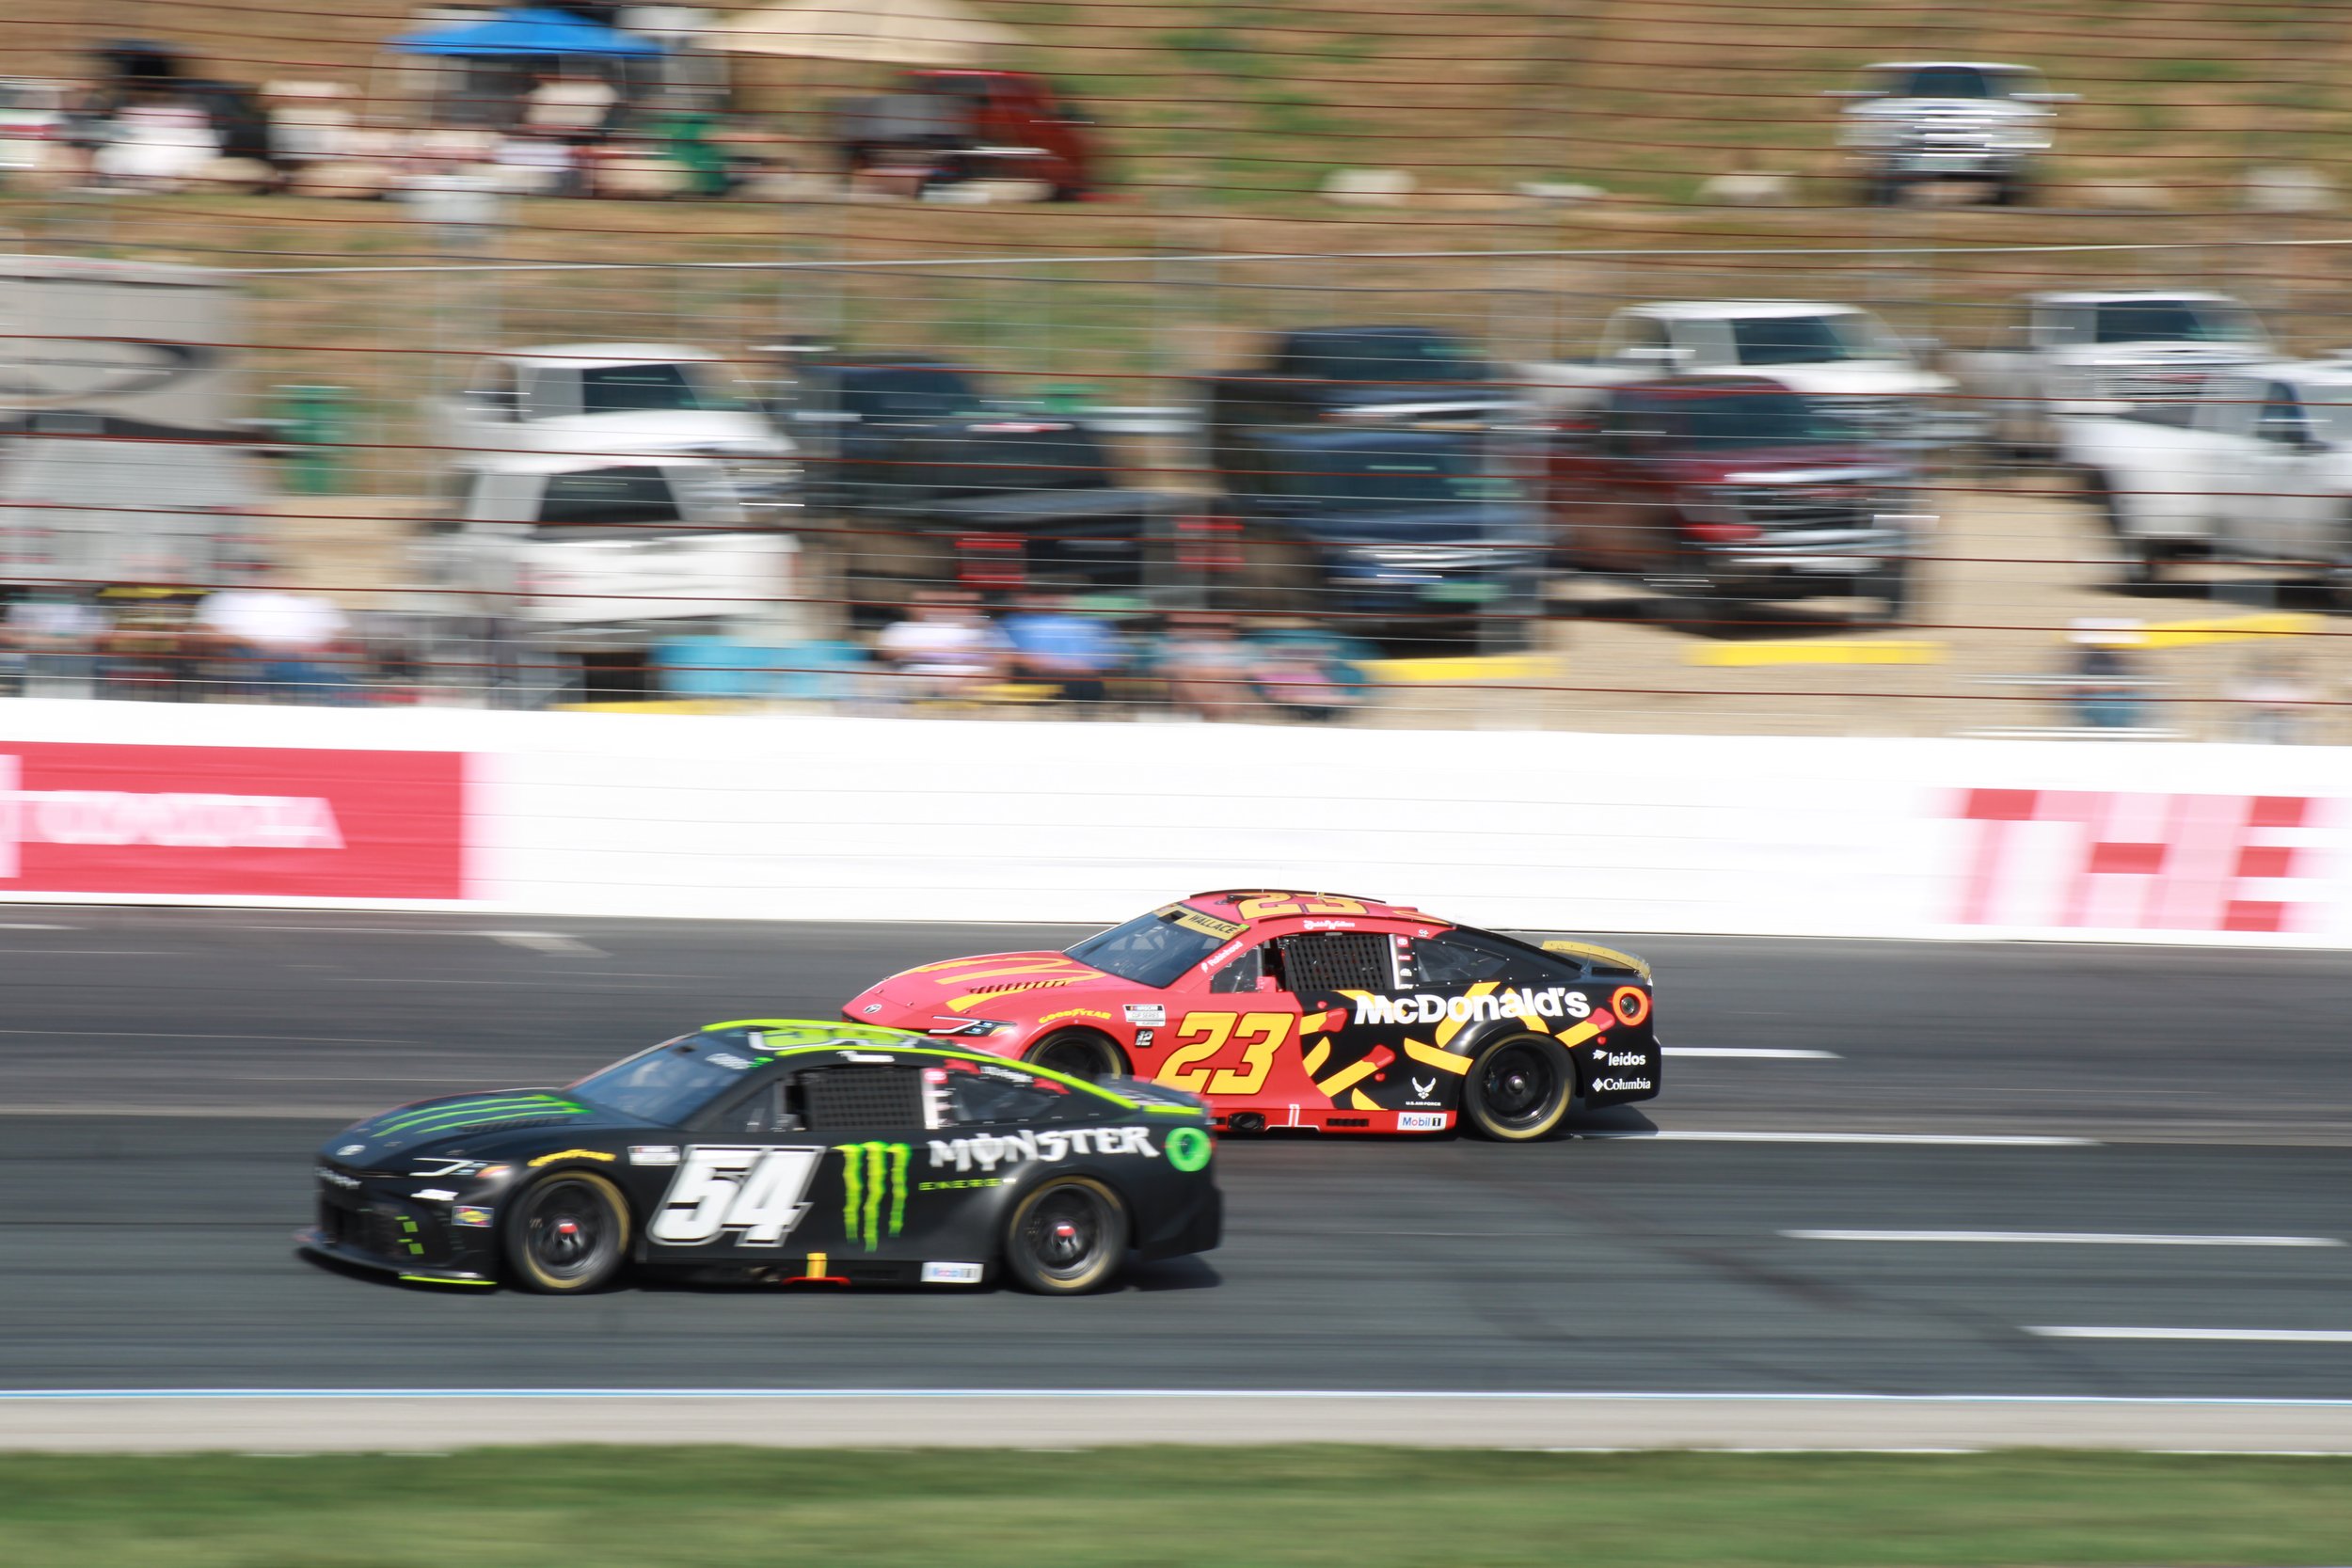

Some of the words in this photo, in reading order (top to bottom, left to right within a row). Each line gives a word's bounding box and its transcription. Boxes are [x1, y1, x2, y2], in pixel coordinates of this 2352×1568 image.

[1940, 788, 2333, 932] THE
[1188, 913, 1236, 934] WALLACE
[1039, 1007, 1112, 1024] GOODYEAR
[1354, 988, 1591, 1024] McDonald's
[1135, 1030, 1153, 1046] 12
[1151, 1011, 1295, 1095] 23
[1608, 1052, 1646, 1067] leidos
[1603, 1078, 1651, 1090] Columbia
[1402, 1117, 1430, 1126] Mobil
[928, 1126, 1160, 1171] MONSTER
[645, 1144, 826, 1247] 54
